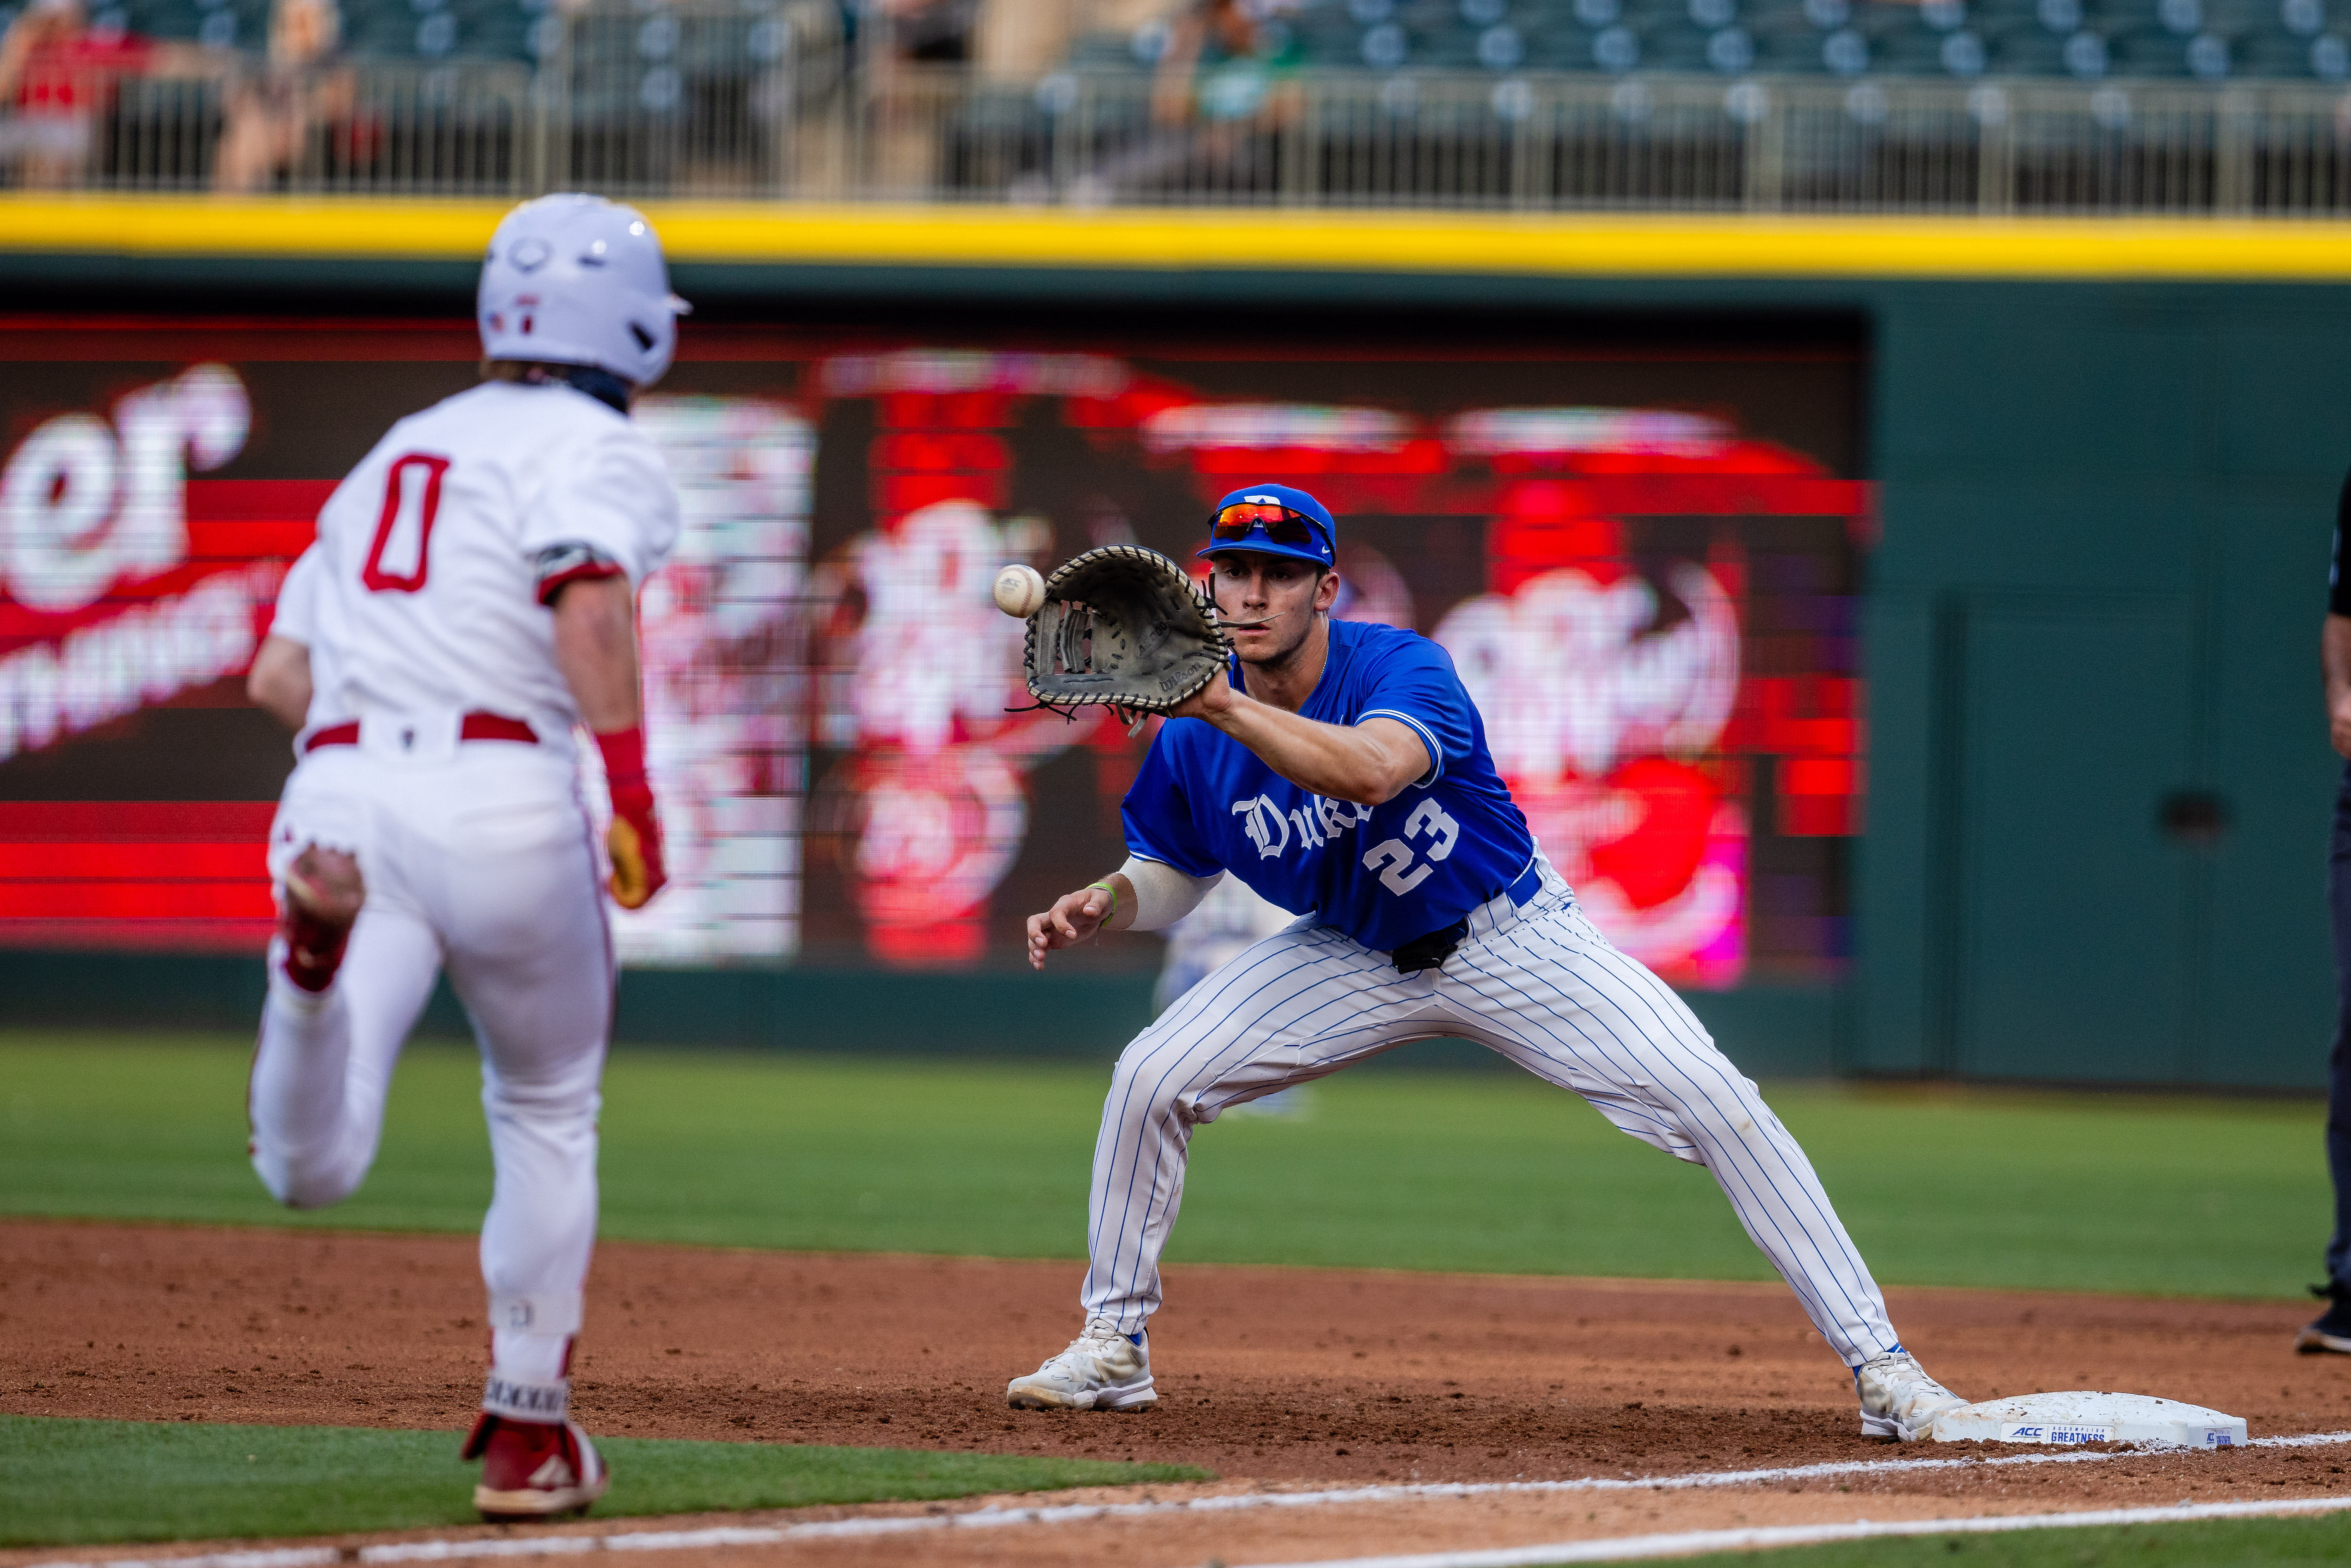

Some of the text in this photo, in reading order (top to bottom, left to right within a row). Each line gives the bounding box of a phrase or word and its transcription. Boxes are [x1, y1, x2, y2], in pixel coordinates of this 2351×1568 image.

[362, 452, 451, 593] 0
[1159, 661, 1202, 692] Wilson
[1362, 797, 1459, 896] 23
[2012, 1427, 2043, 1436] ACC
[2051, 1432, 2105, 1443] GREATNESS
